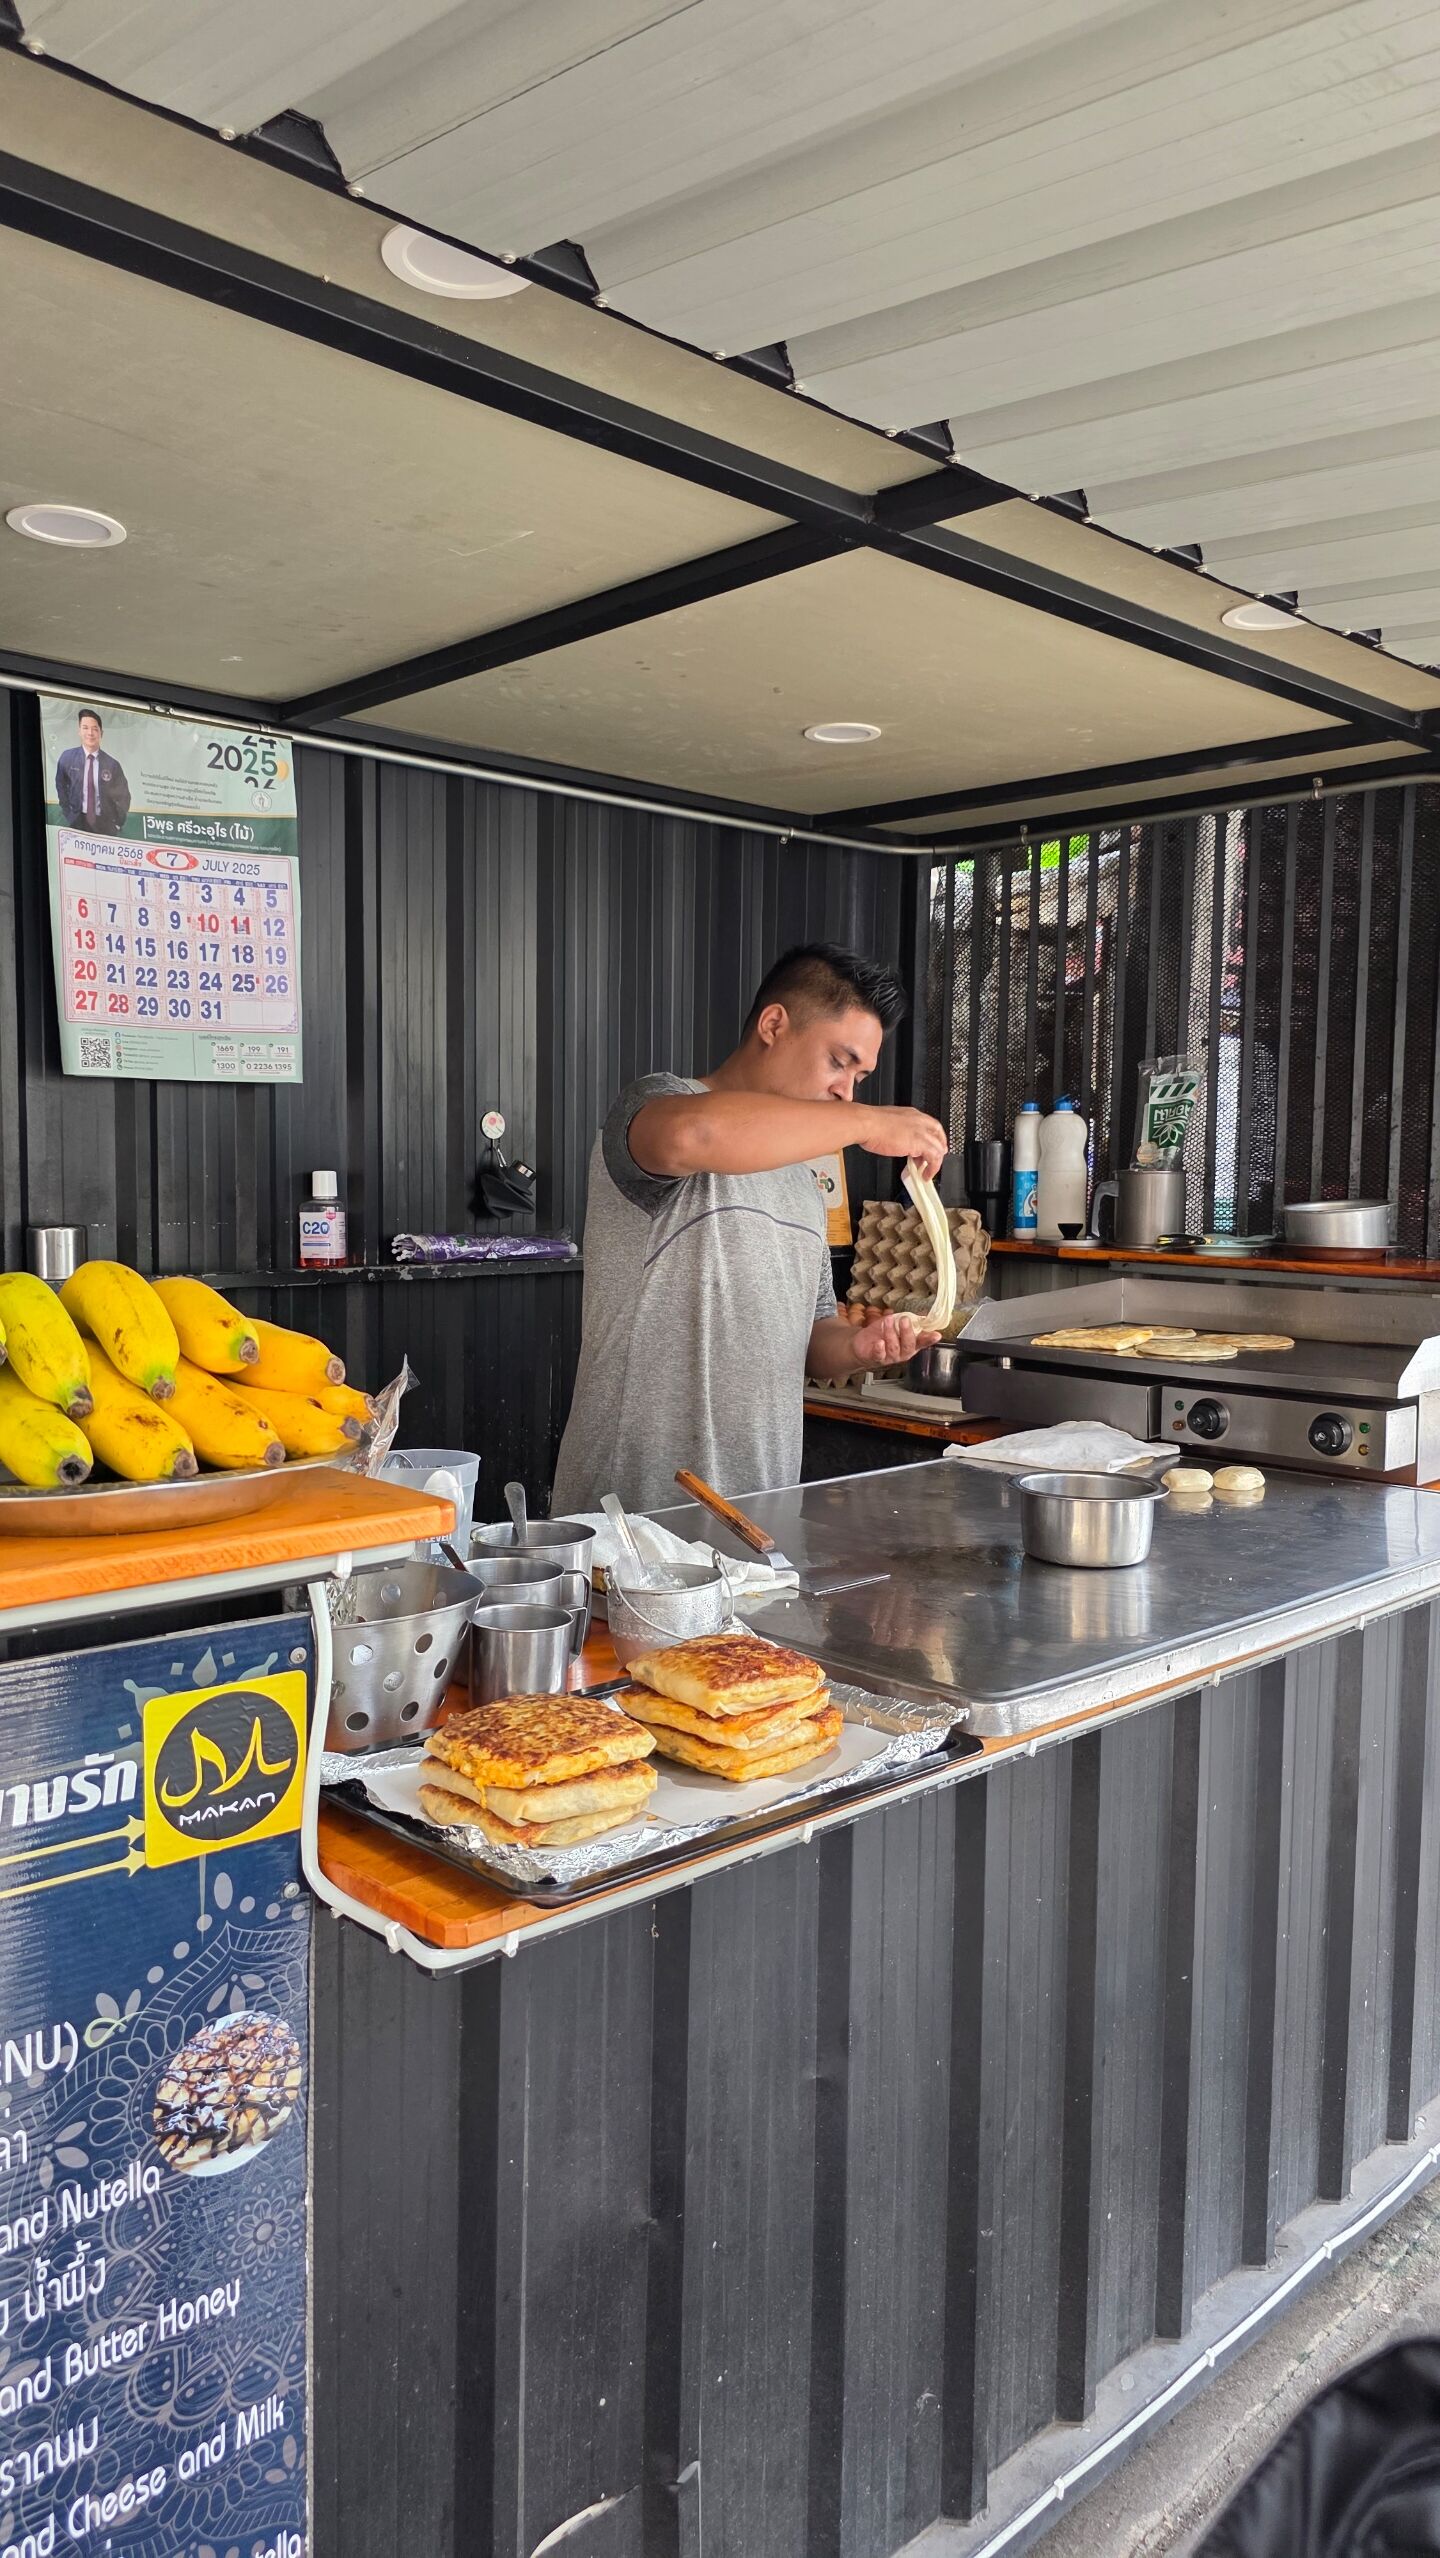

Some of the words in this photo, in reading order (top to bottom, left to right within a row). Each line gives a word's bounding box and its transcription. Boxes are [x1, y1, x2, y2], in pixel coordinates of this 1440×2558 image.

[206, 742, 278, 777] 2025
[146, 815, 174, 835] วิพุธ
[178, 819, 227, 841] ศรีวะอุไร
[74, 839, 115, 856] กรกฎาคม
[117, 846, 143, 859] 2568
[166, 852, 178, 867] 7
[202, 859, 230, 873] JULY
[232, 862, 260, 876] 2025
[137, 877, 146, 897] 1
[168, 881, 180, 900] 2
[201, 884, 212, 903] 3
[233, 887, 245, 906] 4
[266, 890, 278, 908] 5
[77, 898, 89, 918] 6
[107, 903, 117, 923] 7
[138, 907, 149, 927] 8
[169, 910, 181, 930] 9
[197, 913, 220, 934] 10
[231, 915, 250, 935] 11
[263, 918, 286, 937] 12
[74, 928, 96, 950] 13
[105, 933, 125, 954] 14
[135, 936, 156, 958] 15
[167, 940, 188, 960] 16
[199, 943, 220, 962] 17
[232, 944, 254, 964] 18
[265, 946, 287, 965] 19
[74, 959, 97, 981] 20
[106, 963, 126, 984] 21
[135, 966, 158, 987] 22
[167, 969, 190, 989] 23
[199, 972, 223, 992] 24
[232, 973, 256, 993] 25
[265, 974, 288, 994] 26
[75, 990, 98, 1011] 27
[108, 993, 129, 1014] 28
[137, 996, 159, 1017] 29
[168, 998, 191, 1019] 30
[200, 1000, 222, 1020] 31
[217, 1062, 236, 1070] 1300
[179, 1792, 275, 1827] MAKAN
[0, 2021, 79, 2085] NU)
[62, 2160, 160, 2228] Nutella
[25, 2239, 106, 2322] น้ำผึ้ง
[0, 2355, 51, 2417] and
[65, 2321, 147, 2386] Butter
[159, 2278, 240, 2341] Honey
[68, 2465, 167, 2539] Cheese
[178, 2421, 226, 2480] and
[236, 2393, 285, 2450] Milk
